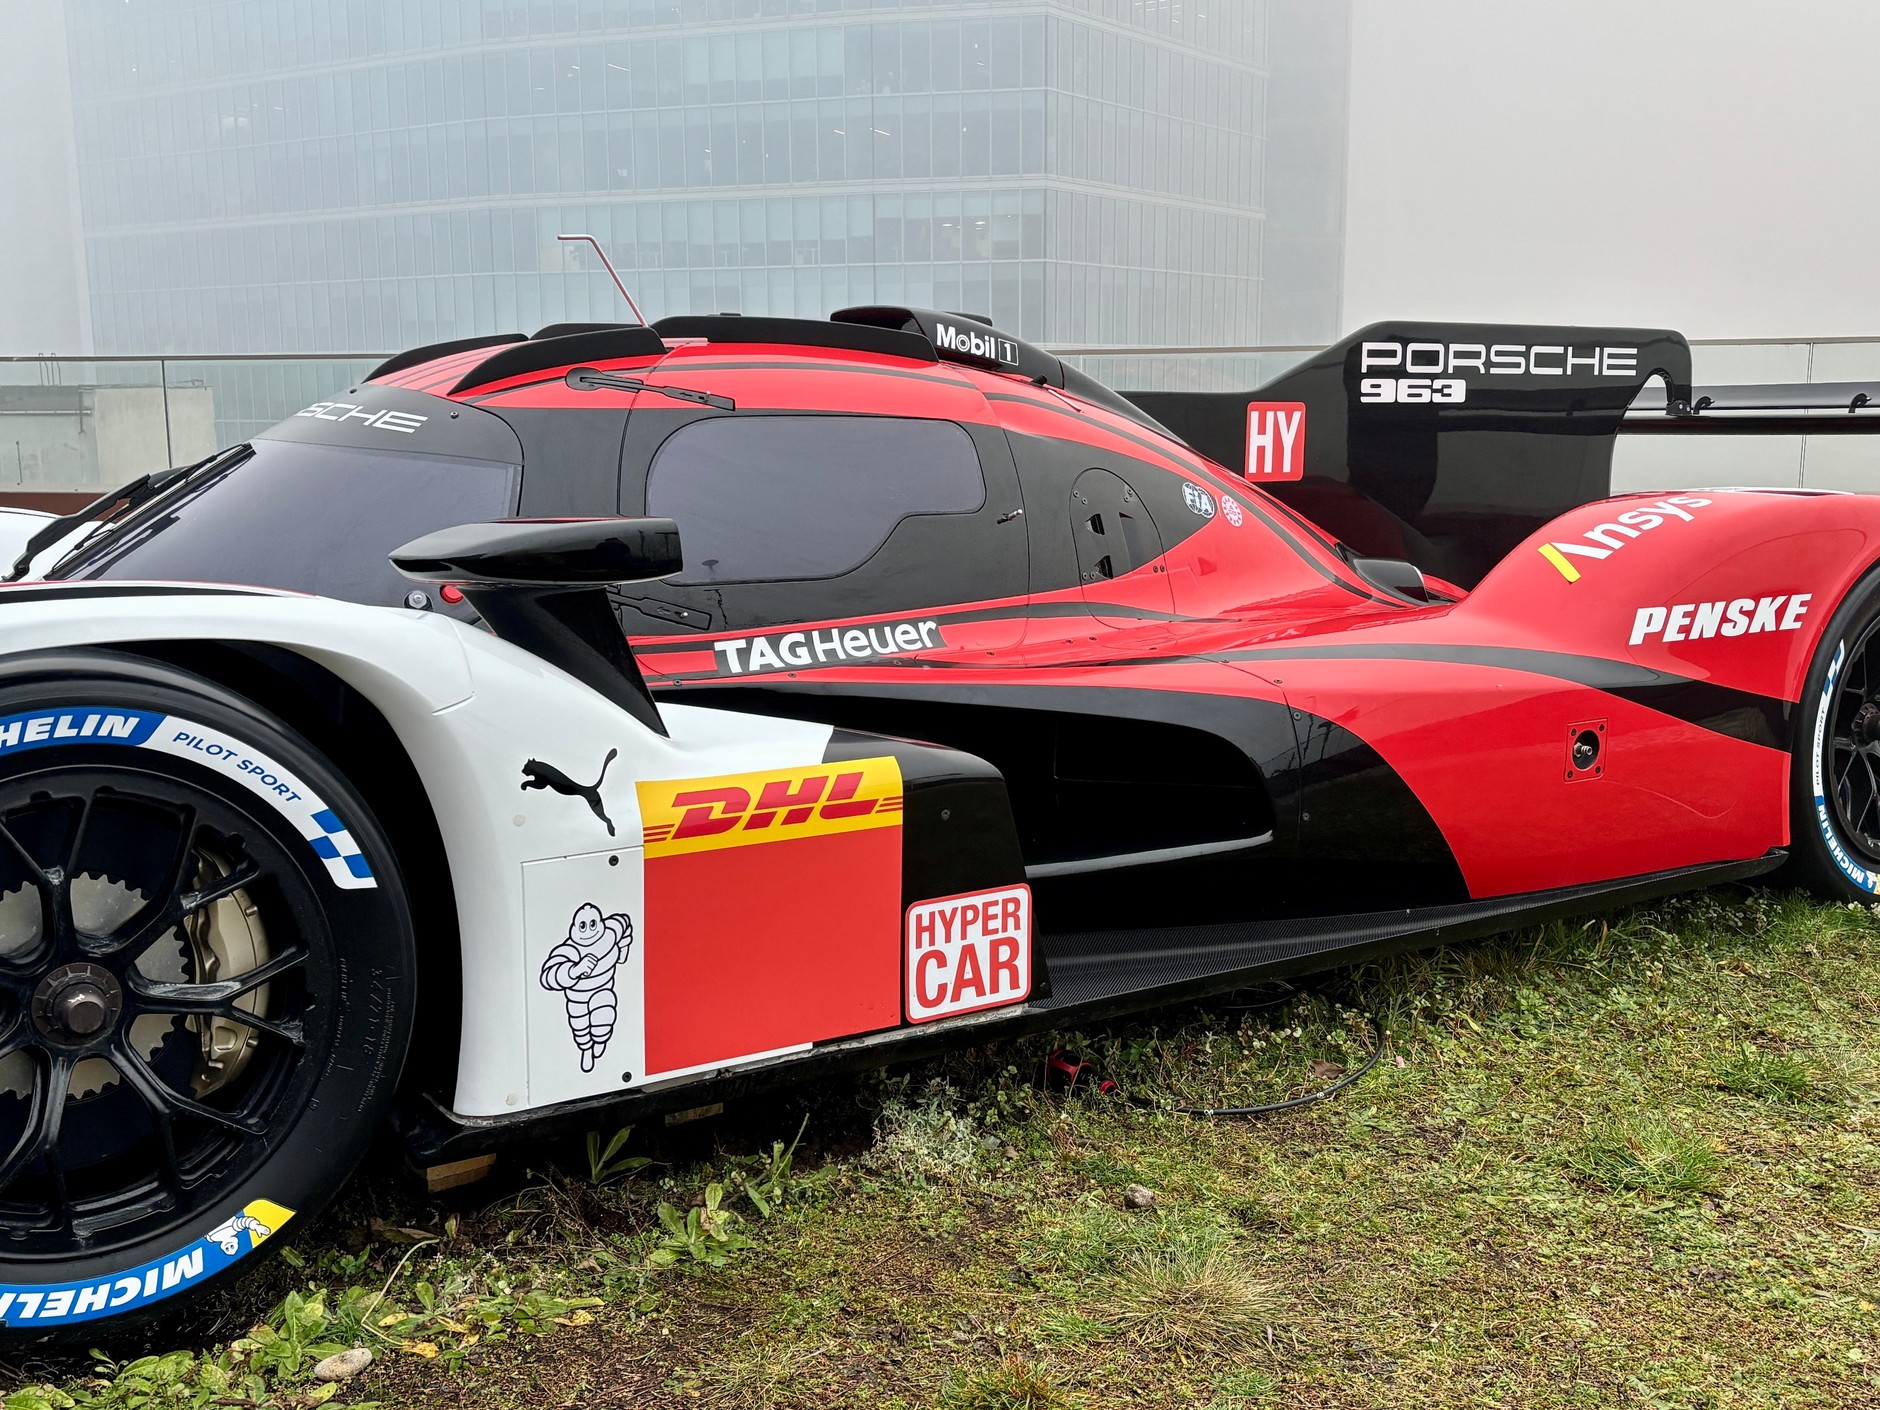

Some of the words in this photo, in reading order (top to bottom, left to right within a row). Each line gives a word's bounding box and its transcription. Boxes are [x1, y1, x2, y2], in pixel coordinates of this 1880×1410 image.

[936, 323, 996, 360] Mobil
[1360, 341, 1638, 376] PORSCHE
[1360, 378, 1467, 403] 963
[1248, 410, 1302, 474] HY
[1184, 485, 1214, 516] FIA
[1628, 593, 1813, 646] PENSKE
[1816, 706, 1826, 749] SPORT
[172, 731, 238, 761] PILOT
[236, 759, 302, 802] SPORT
[671, 771, 880, 840] DHL
[1818, 804, 1865, 884] MICHELIN
[915, 897, 1021, 949] HYPER
[915, 936, 1021, 1009] CAR
